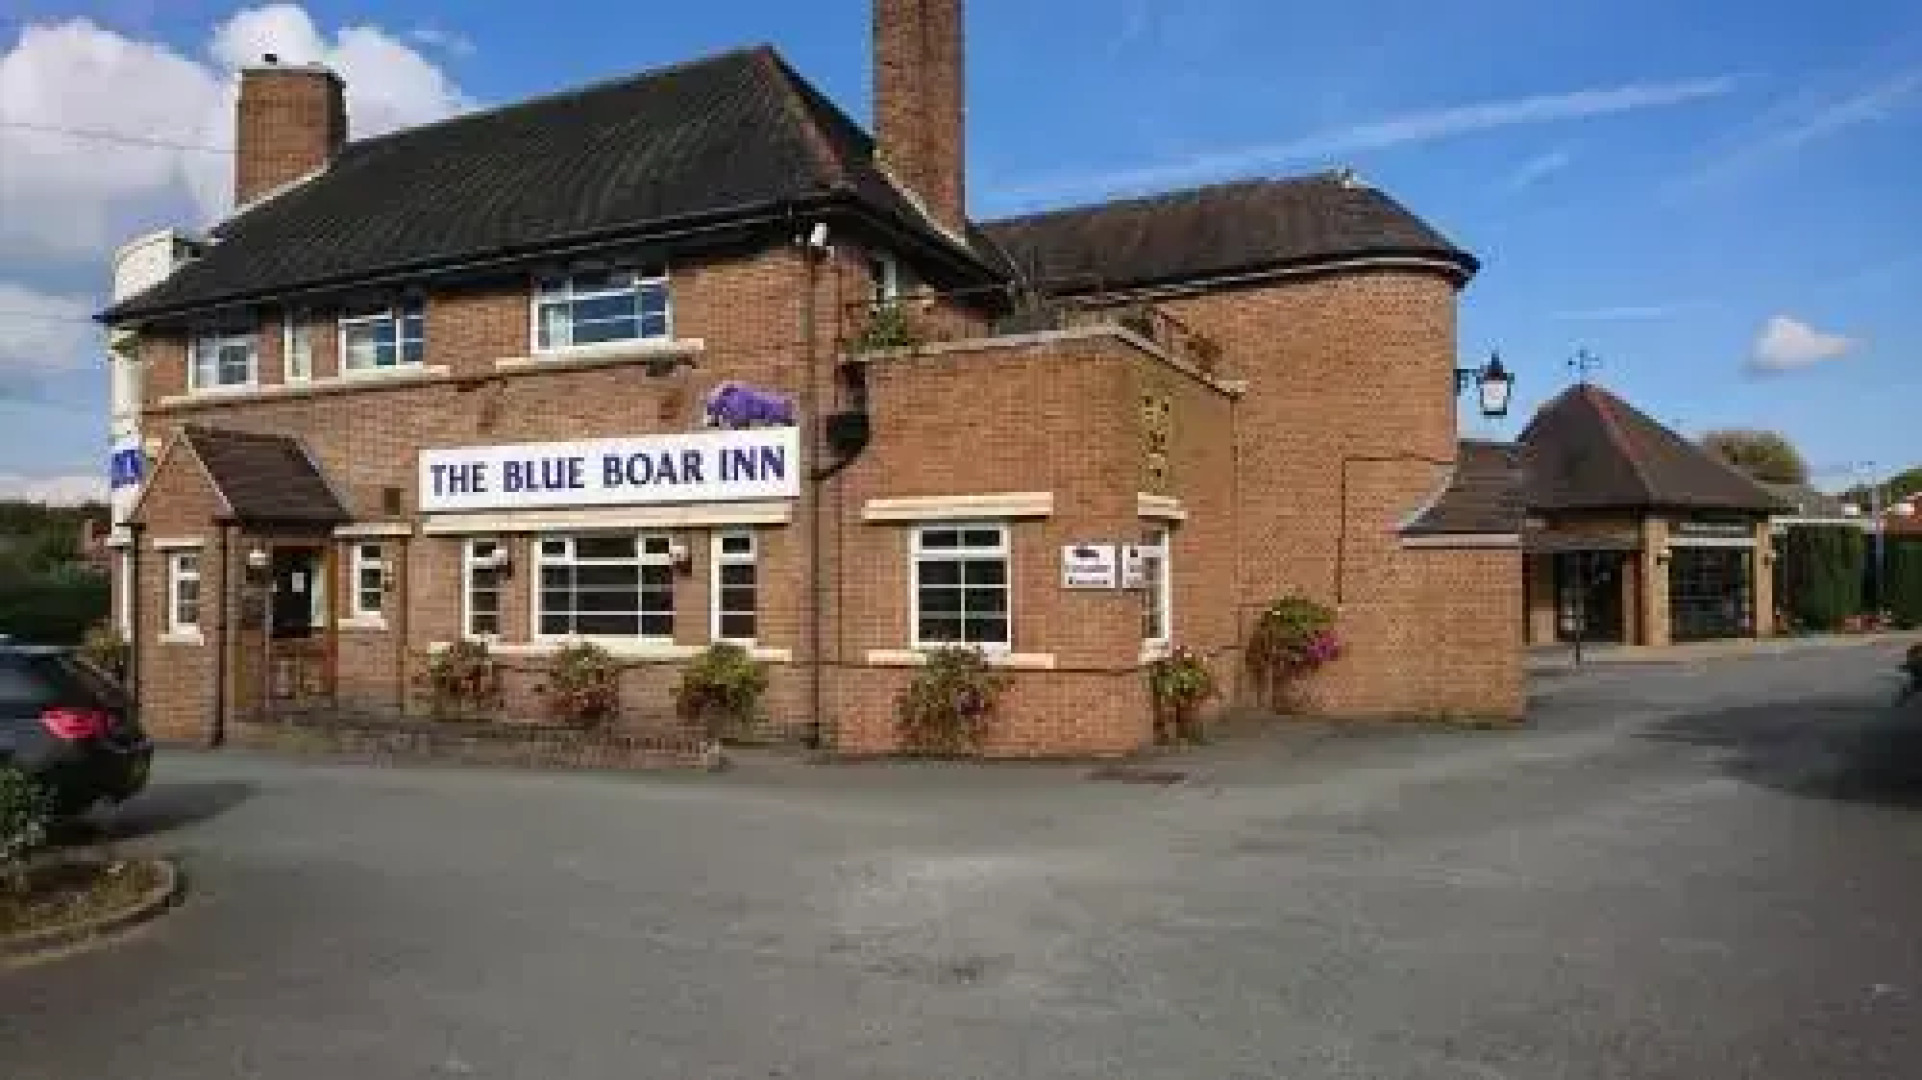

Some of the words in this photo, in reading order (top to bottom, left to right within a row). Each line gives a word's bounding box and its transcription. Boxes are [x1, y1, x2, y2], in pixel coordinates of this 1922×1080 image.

[430, 462, 488, 496] THE
[503, 457, 585, 492] BLUE
[603, 450, 704, 487] BOAR
[719, 446, 785, 481] INN
